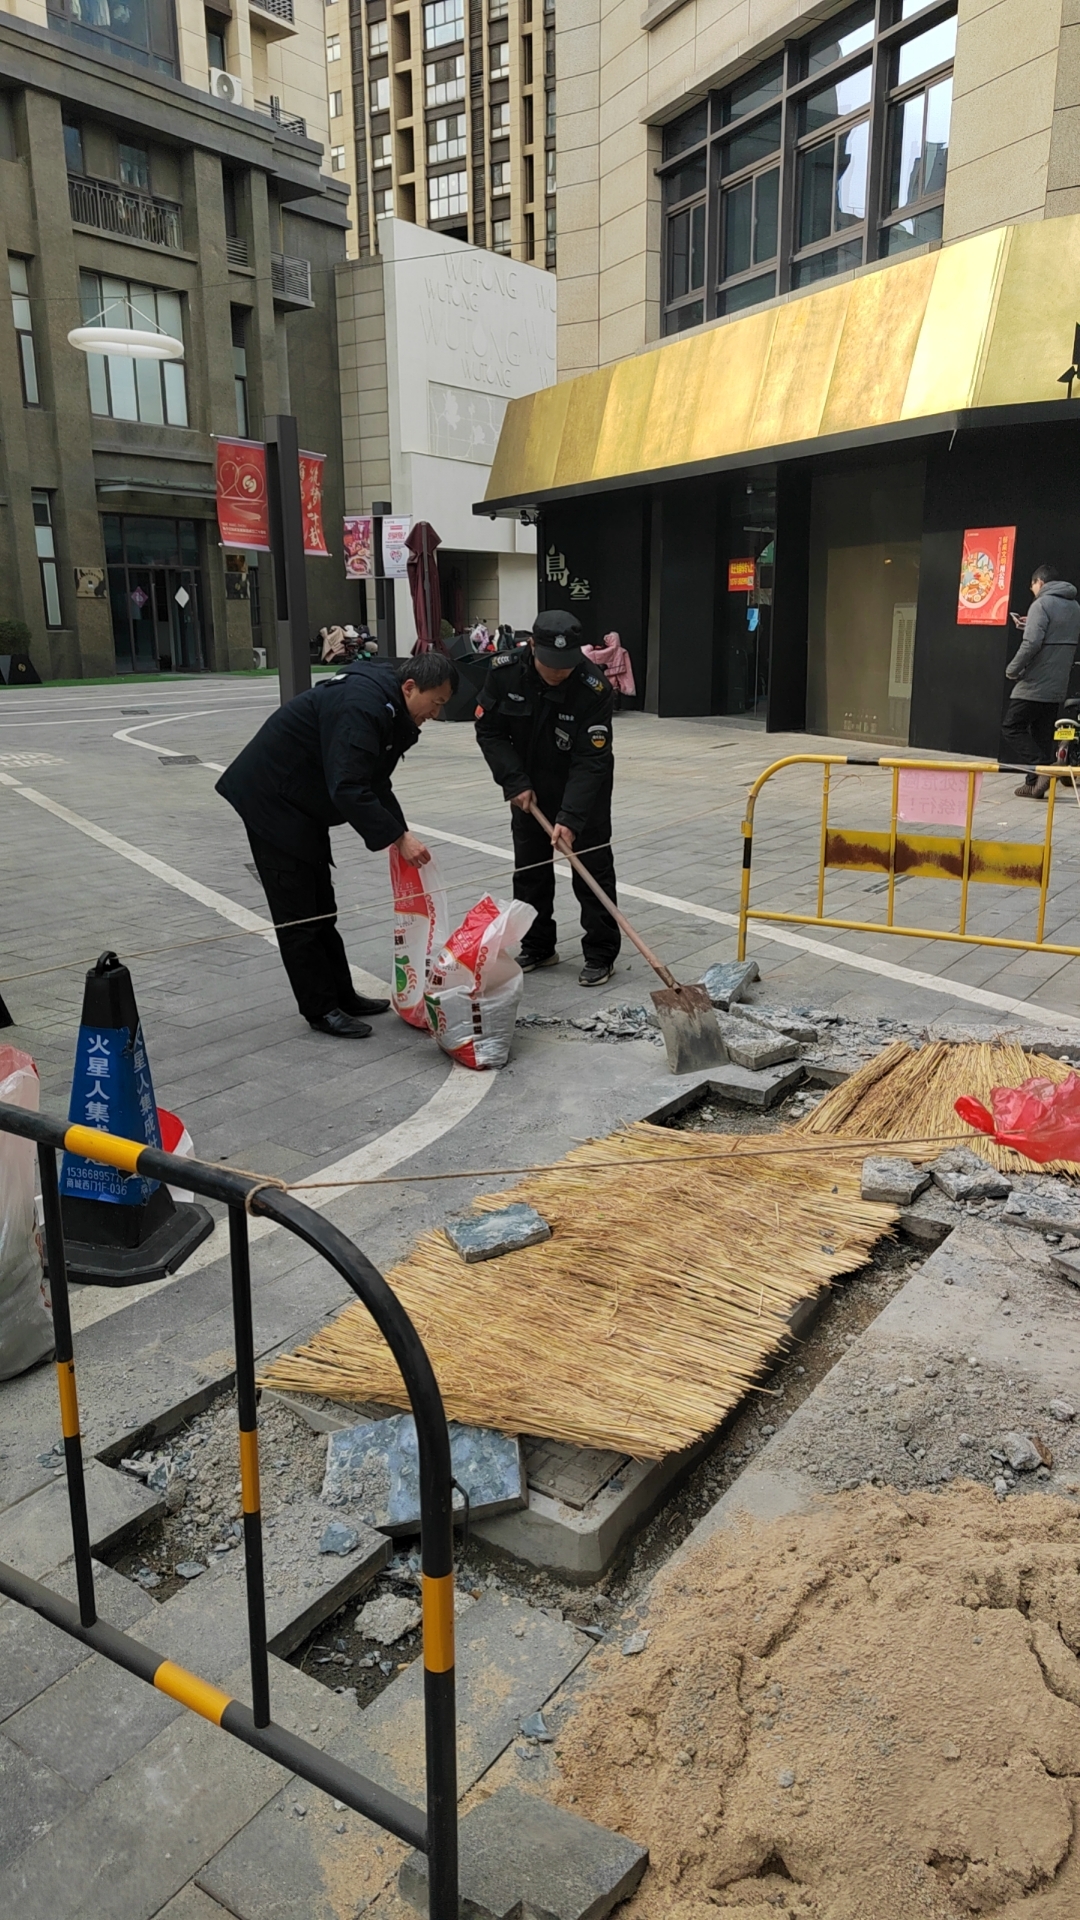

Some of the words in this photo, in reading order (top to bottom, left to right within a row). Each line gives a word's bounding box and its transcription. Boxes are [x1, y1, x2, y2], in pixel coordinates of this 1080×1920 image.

[424, 277, 479, 312] WUTONG
[443, 250, 518, 300] WUTONG
[419, 303, 521, 367] WUTONG
[461, 358, 512, 388] WUTONG
[84, 1034, 111, 1168] 火星人集
